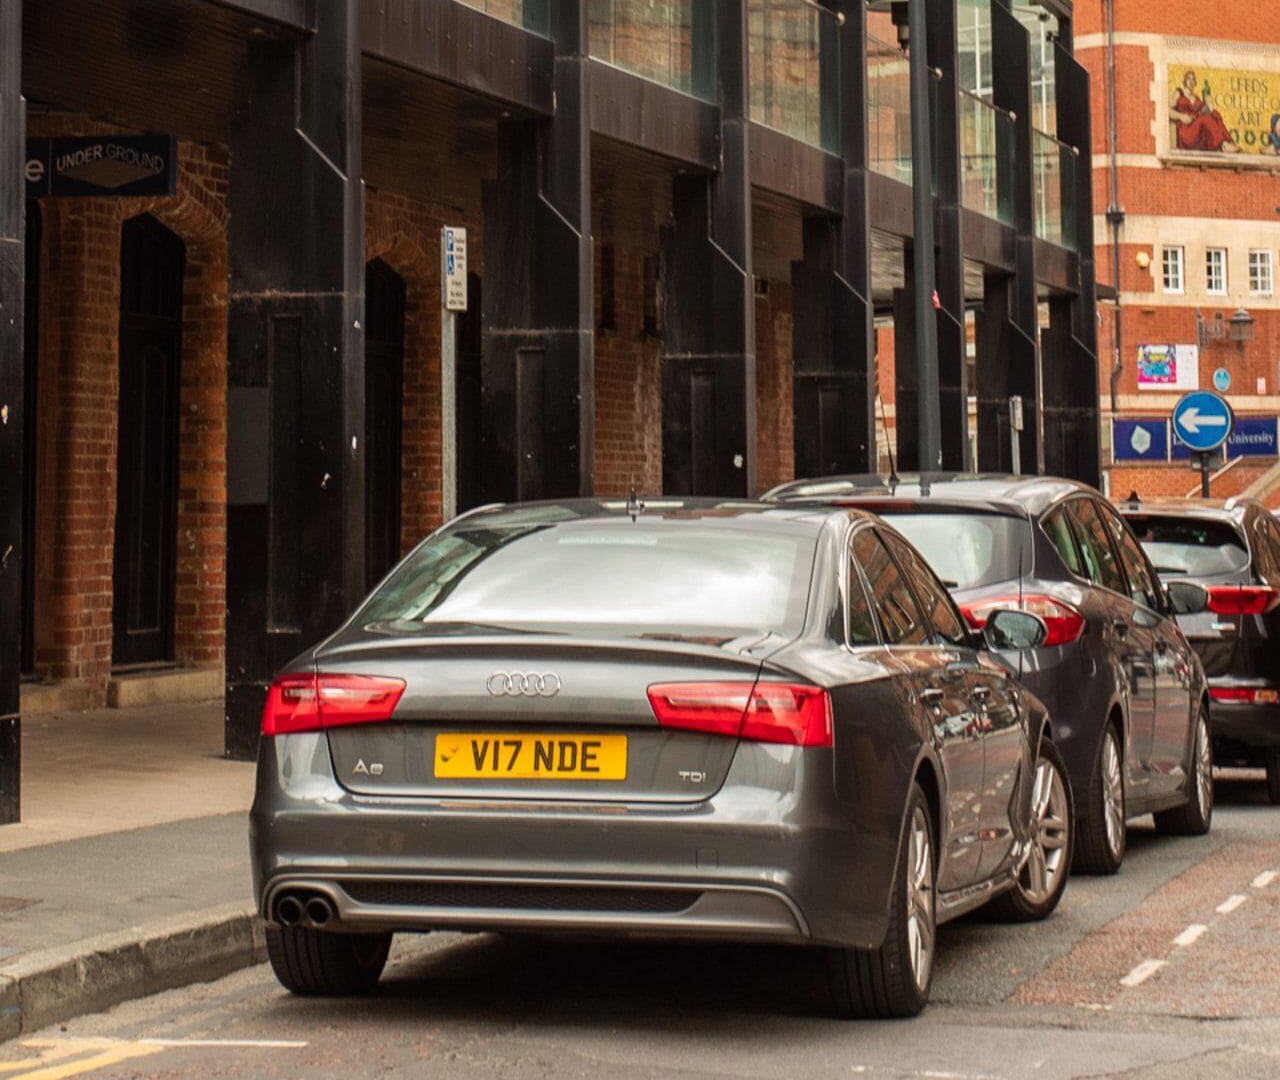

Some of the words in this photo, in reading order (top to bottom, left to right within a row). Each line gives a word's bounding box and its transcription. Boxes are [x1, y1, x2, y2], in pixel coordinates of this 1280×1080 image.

[1230, 76, 1269, 95] LEEDS
[1214, 92, 1267, 111] COLLEGE
[1238, 110, 1261, 126] ART
[56, 144, 103, 172] UNDER
[106, 142, 165, 172] GROUND
[1227, 431, 1274, 446] University
[471, 739, 523, 772] V17
[533, 740, 602, 773] NDE
[678, 770, 706, 783] TDI
